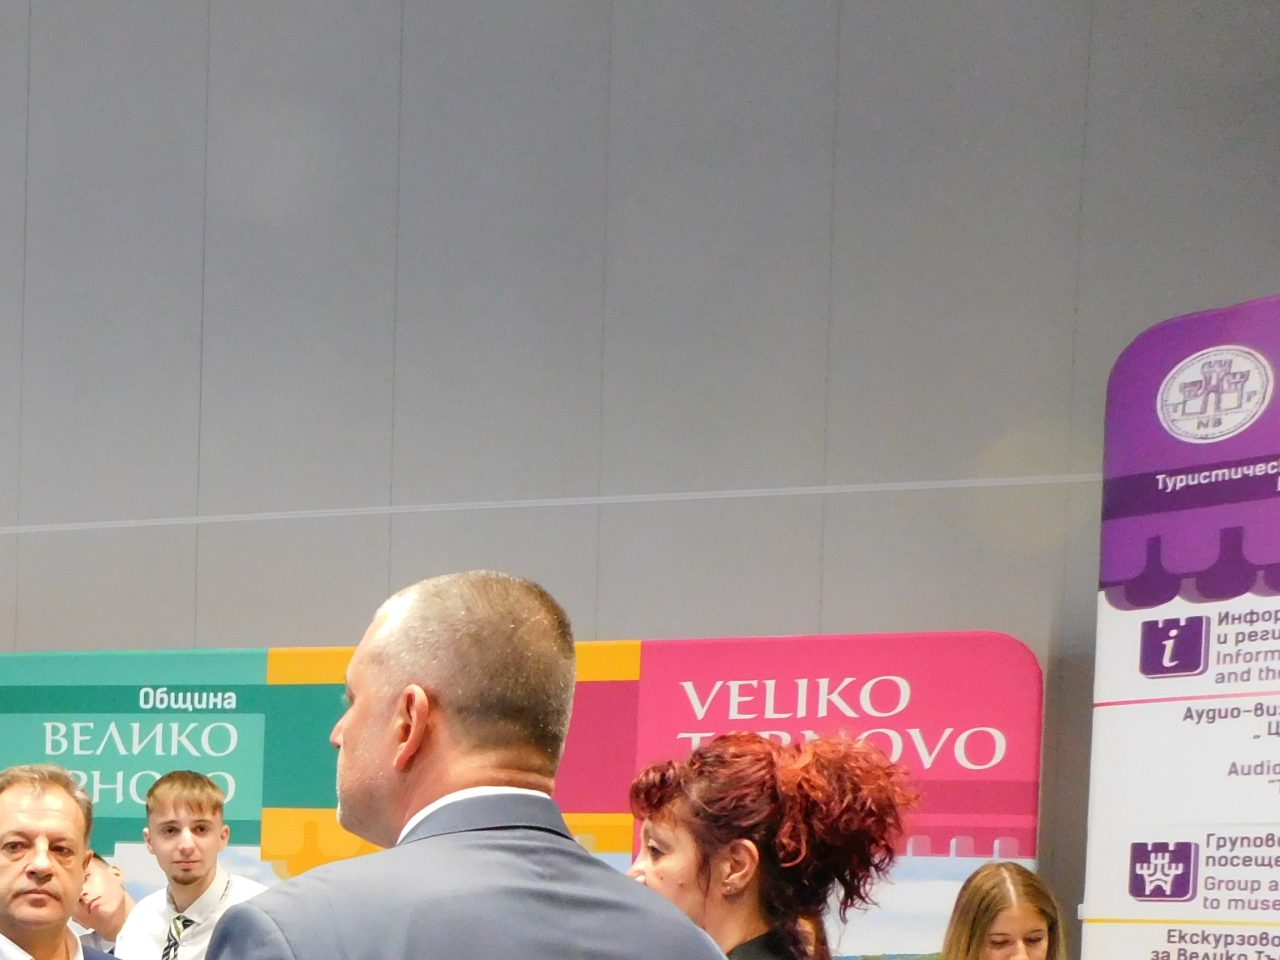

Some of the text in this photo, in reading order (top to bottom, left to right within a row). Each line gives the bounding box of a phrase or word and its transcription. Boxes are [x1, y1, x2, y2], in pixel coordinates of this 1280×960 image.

[1155, 460, 1280, 493] Туристичес
[1214, 667, 1251, 684] and
[139, 686, 238, 712] Община
[678, 675, 912, 721] VELIKO
[42, 720, 239, 758] ВЕЛИКО
[1205, 832, 1280, 853] Групов
[1203, 875, 1261, 895] Group
[1203, 895, 1221, 911] to
